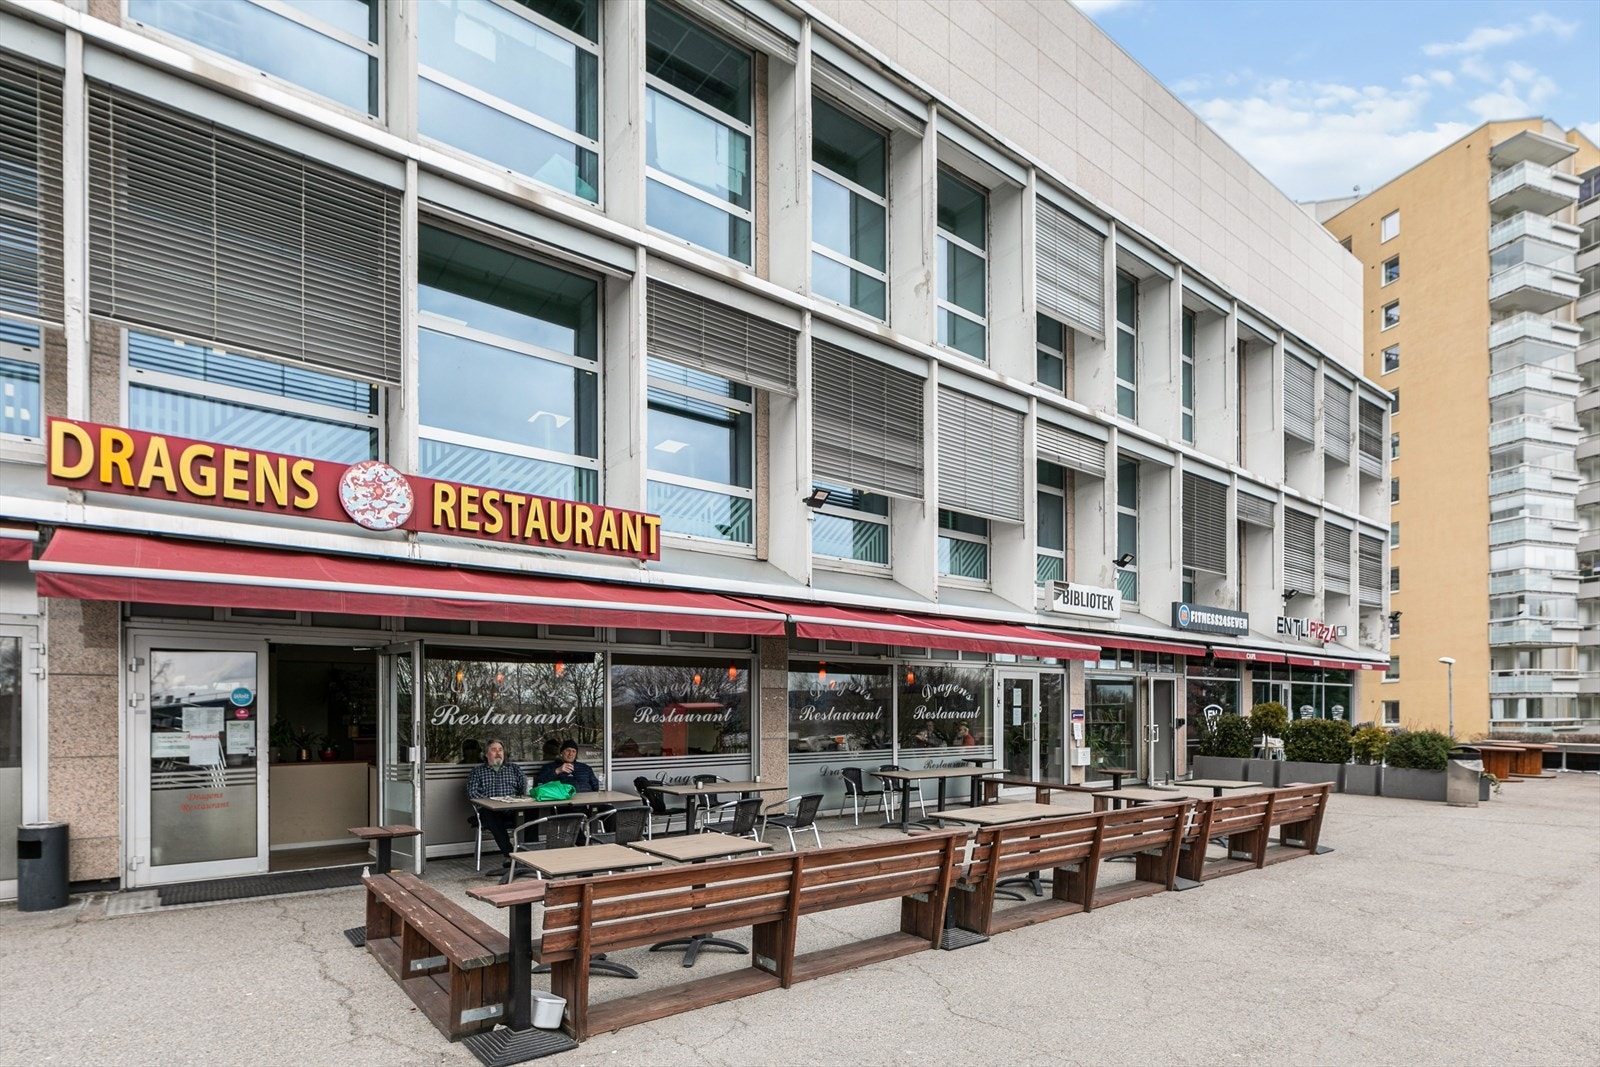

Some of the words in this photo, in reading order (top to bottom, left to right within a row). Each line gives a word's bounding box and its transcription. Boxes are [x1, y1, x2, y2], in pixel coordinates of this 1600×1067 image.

[50, 421, 319, 510] DRAGENS
[432, 482, 662, 555] RESTAURANT
[1062, 589, 1114, 611] BIBLIOTEK
[1190, 611, 1248, 630] FITNESS24SEVEN
[1309, 621, 1337, 643] PIZZA
[921, 683, 974, 702] Dragens
[430, 704, 577, 726] Restaurant
[633, 706, 732, 723] Restaurant
[799, 705, 884, 721] Restaurant
[913, 704, 982, 720] Restaurant
